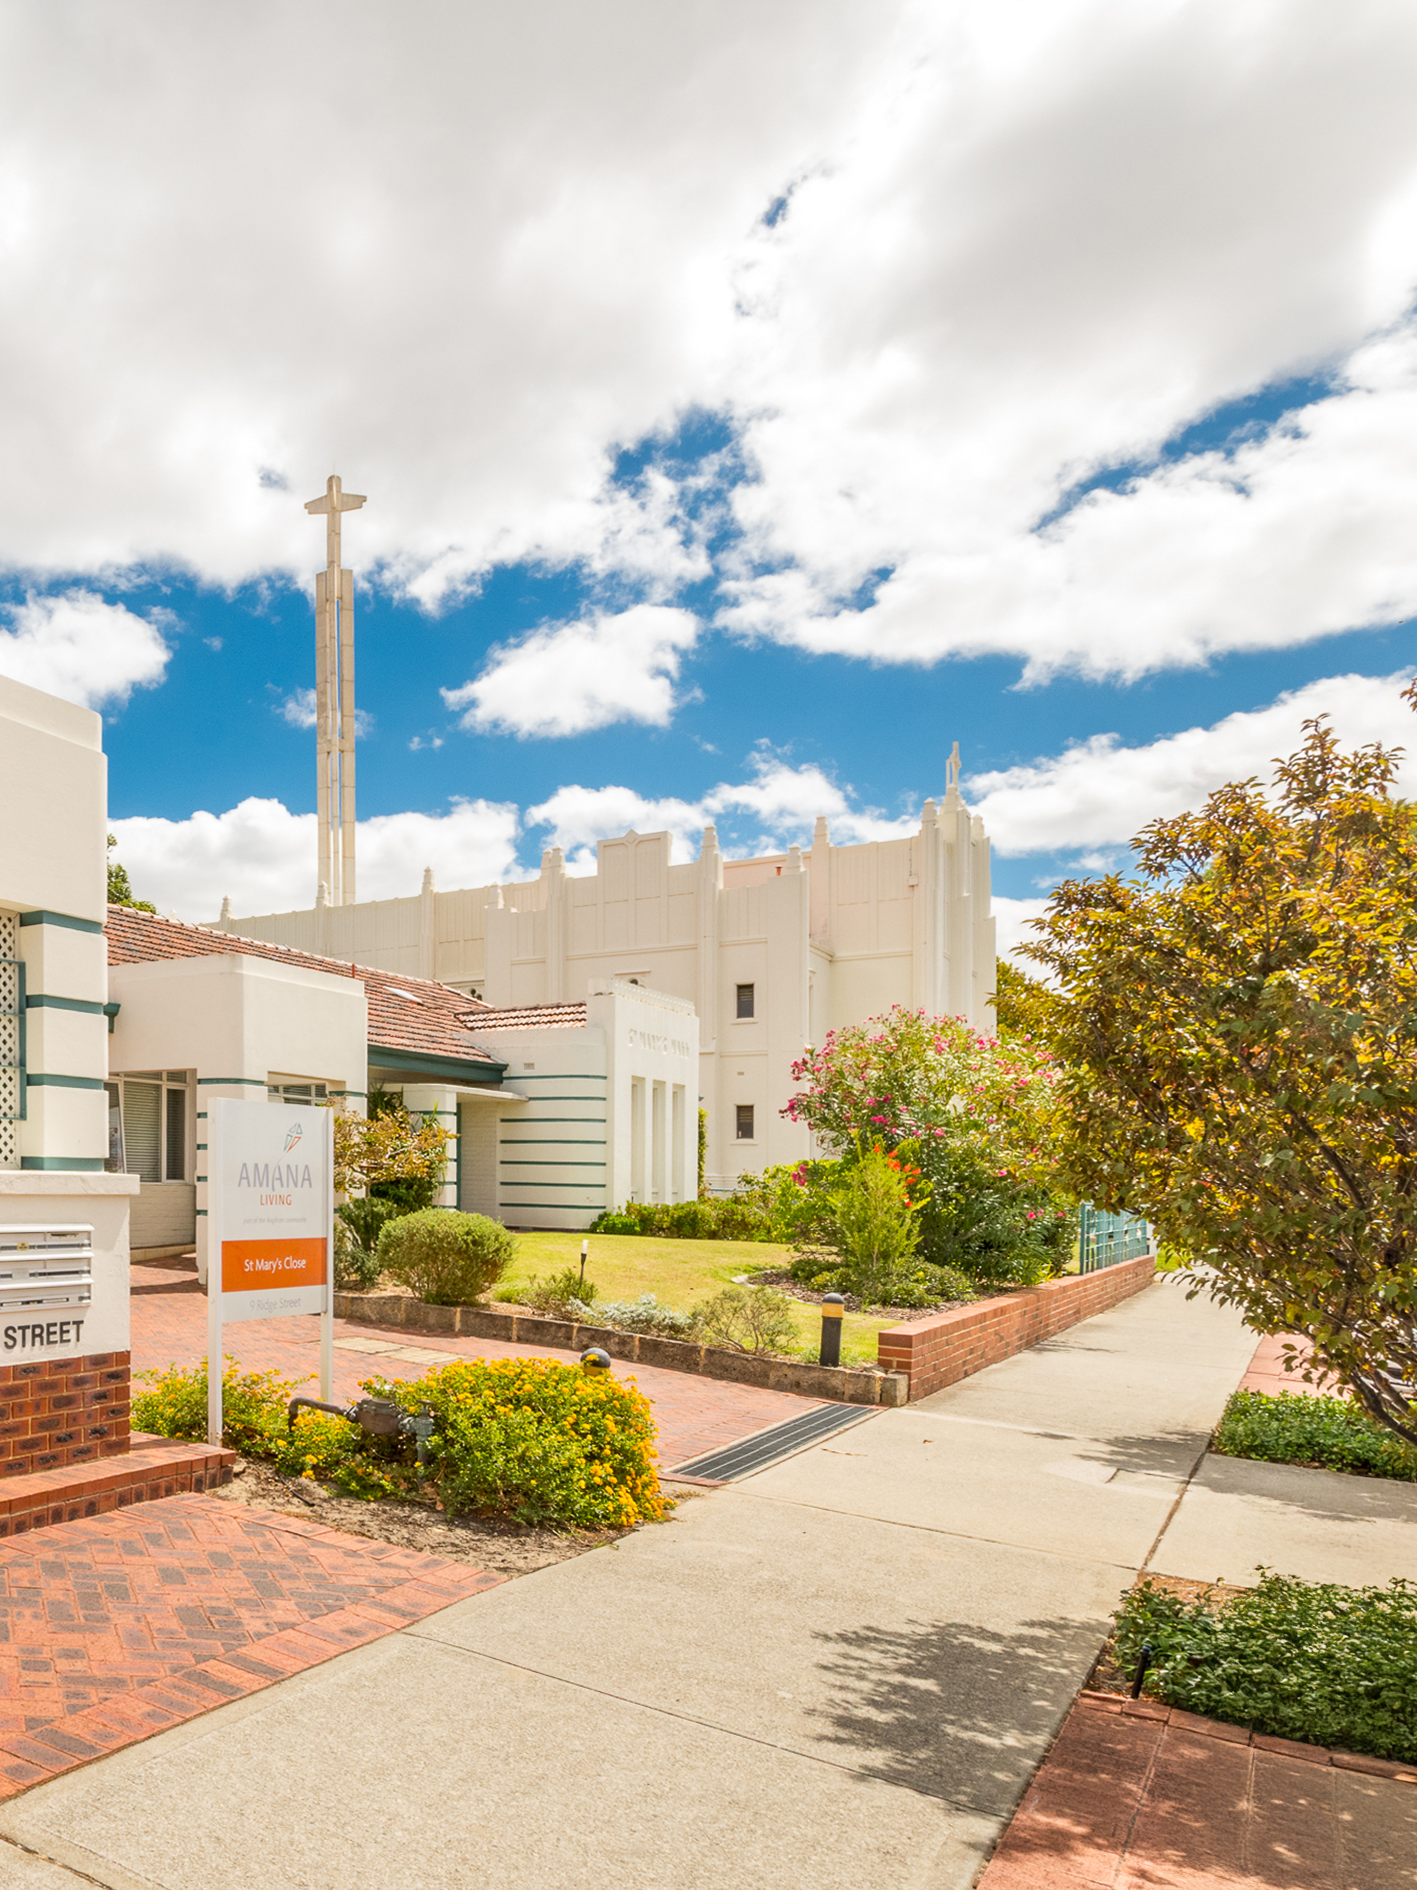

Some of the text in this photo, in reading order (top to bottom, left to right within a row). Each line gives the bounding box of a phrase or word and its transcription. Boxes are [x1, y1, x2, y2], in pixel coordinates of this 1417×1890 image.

[237, 1162, 313, 1191] AMANA
[259, 1194, 293, 1206] LIVING
[244, 1256, 306, 1274] St Mary's Close
[250, 1300, 255, 1310] 9
[3, 1320, 84, 1350] STREET
